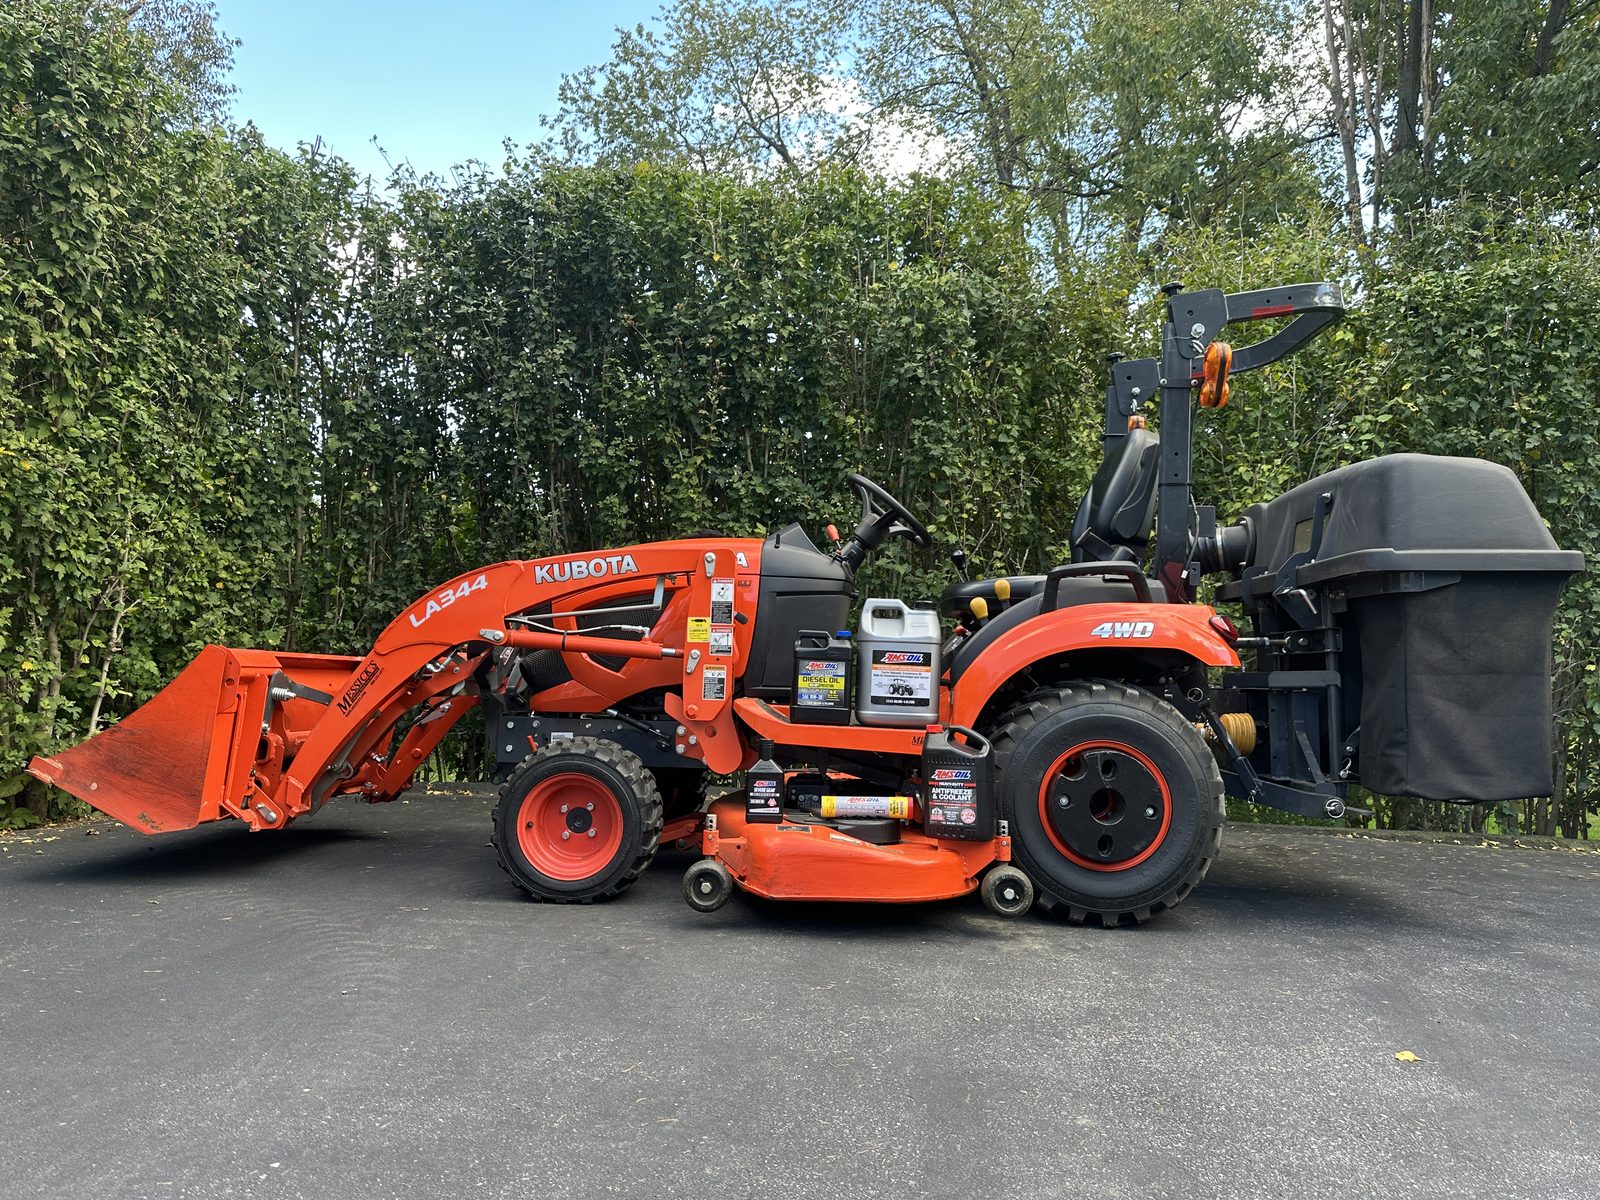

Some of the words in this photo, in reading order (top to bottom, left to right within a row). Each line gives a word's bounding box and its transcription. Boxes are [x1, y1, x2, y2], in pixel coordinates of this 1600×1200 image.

[534, 554, 639, 585] KUBOTA
[408, 574, 489, 628] LA344
[1090, 621, 1155, 639] 4WD
[805, 661, 838, 670] AMSOIL
[881, 652, 924, 663] AMSOIL
[336, 659, 379, 715] MESSICK'S
[931, 769, 971, 780] AMSOIL
